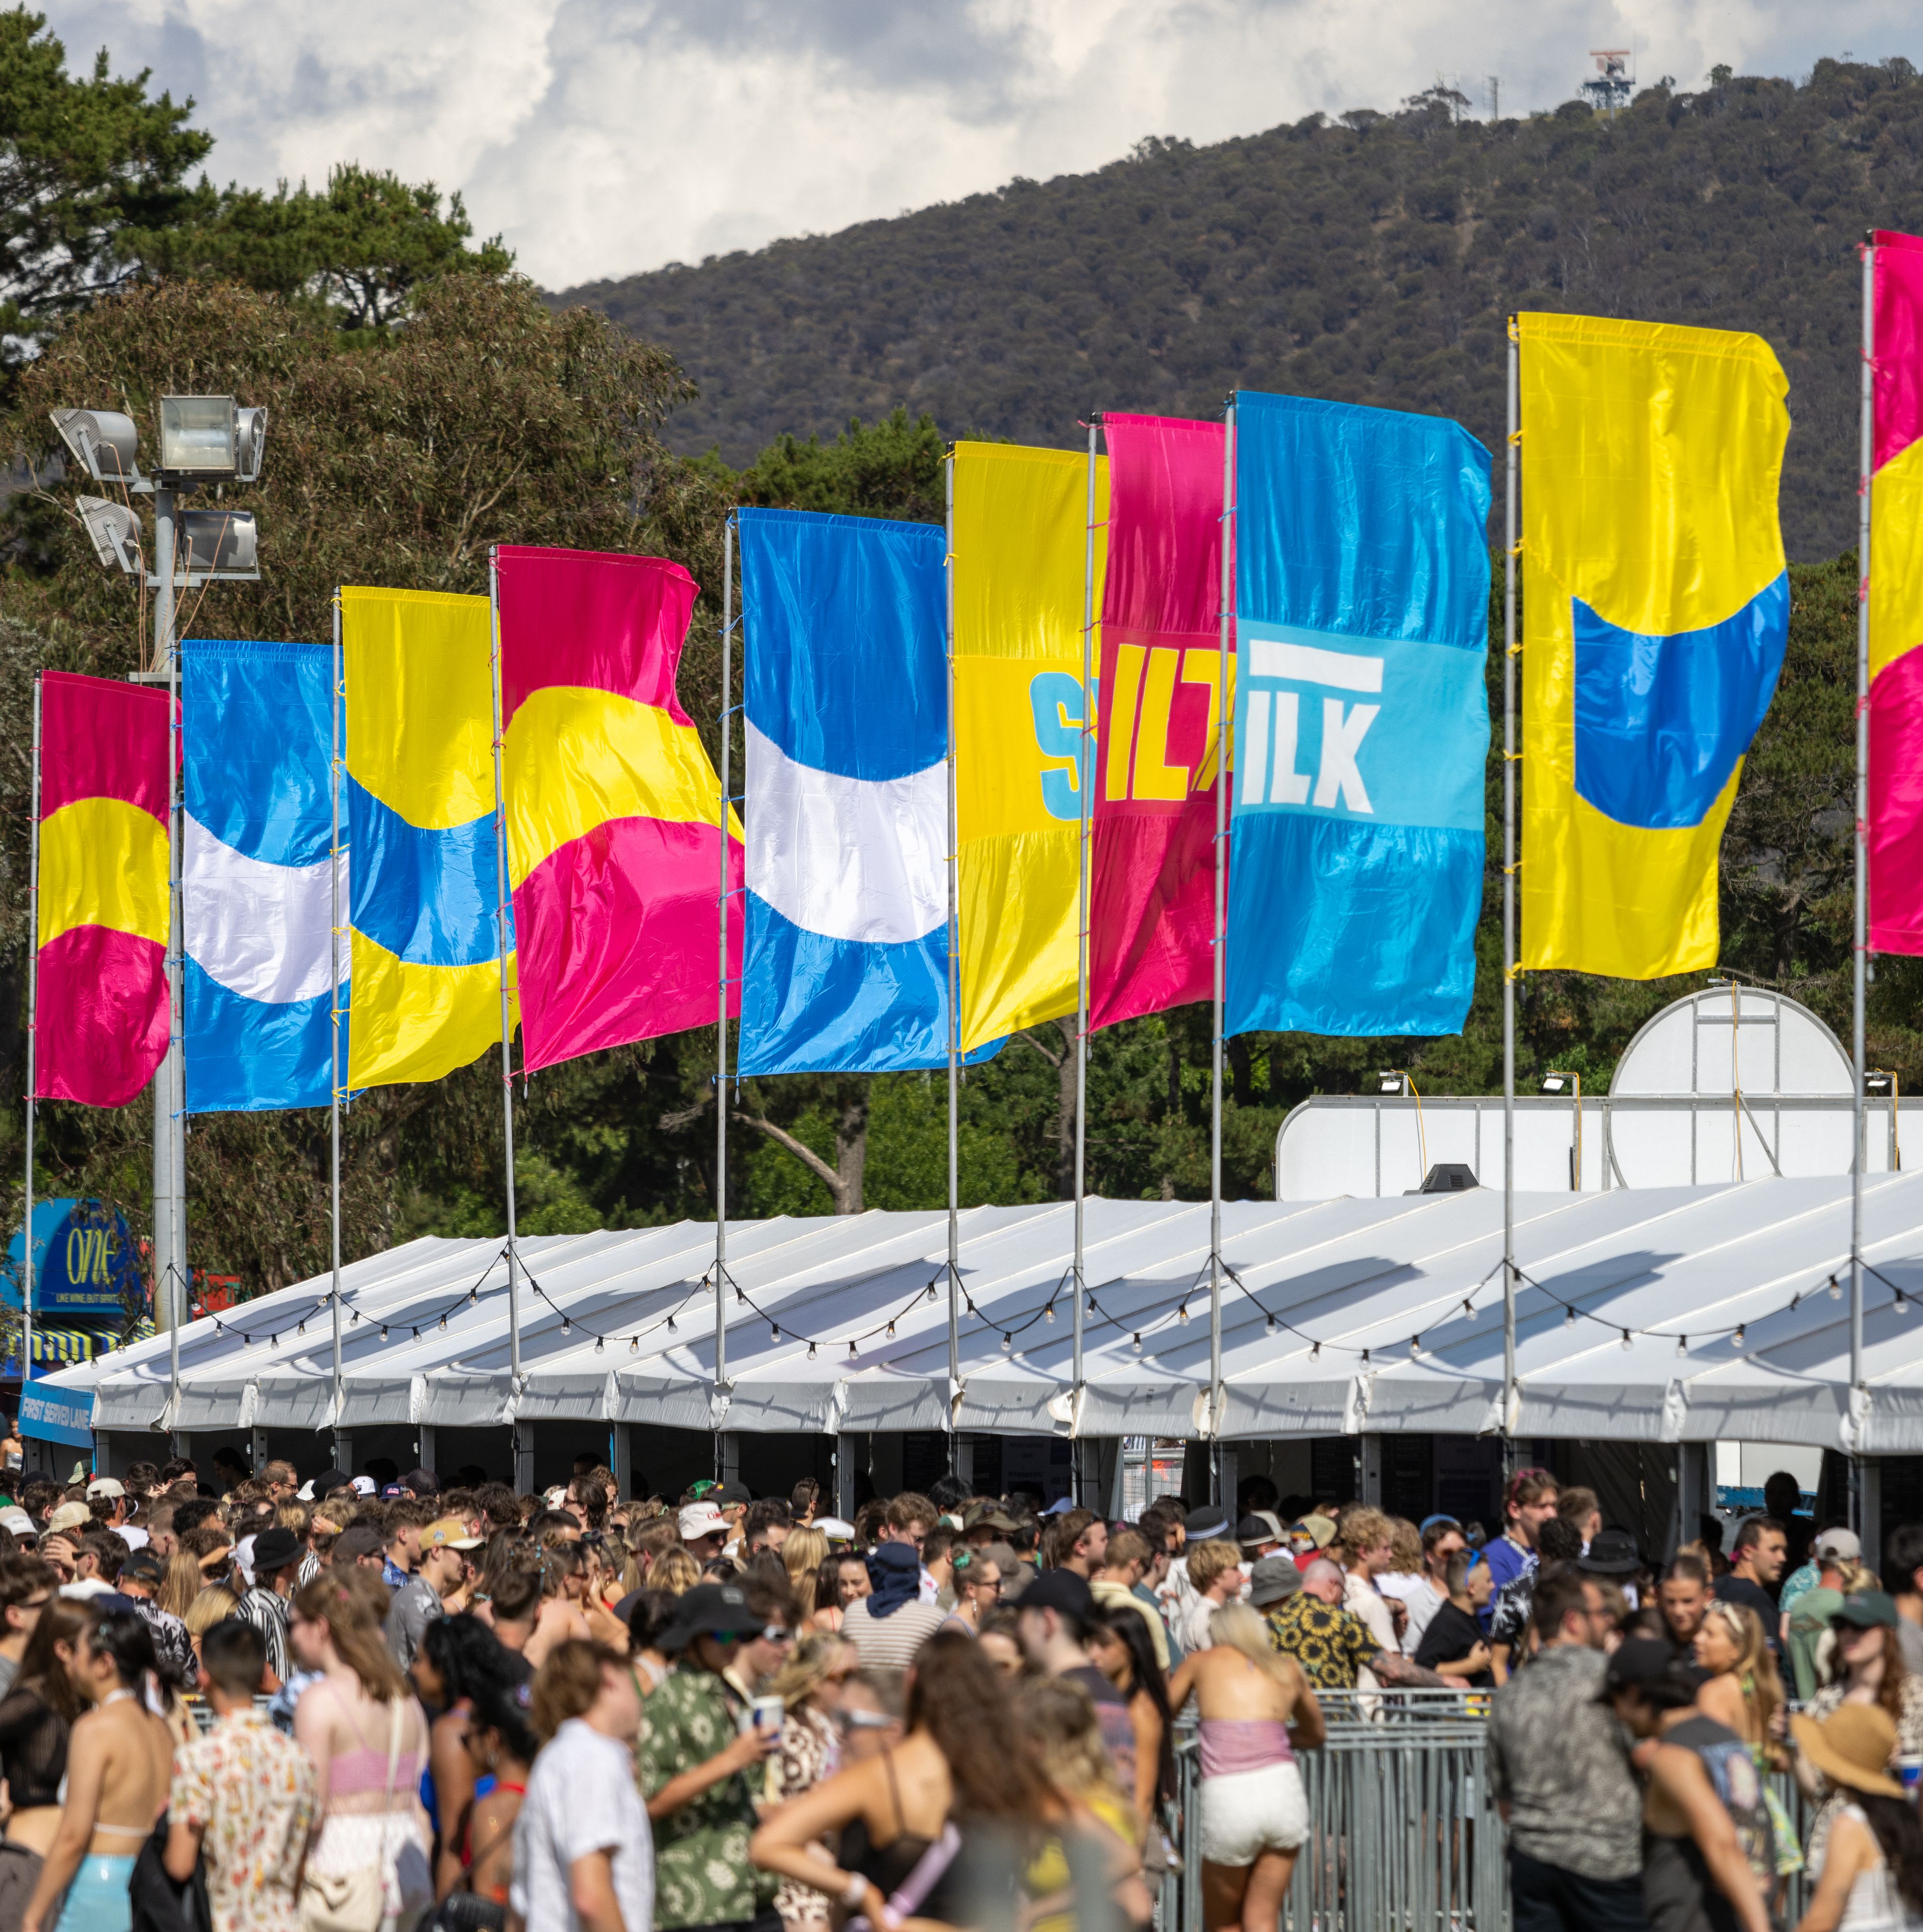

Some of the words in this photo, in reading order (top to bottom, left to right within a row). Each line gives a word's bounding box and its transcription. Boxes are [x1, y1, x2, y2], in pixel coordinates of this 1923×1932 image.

[56, 1294, 69, 1303] LIKE
[87, 1294, 100, 1303] BUT
[22, 1397, 45, 1421] FIRST
[43, 1402, 70, 1427] SERVED
[70, 1407, 90, 1431] LANE
